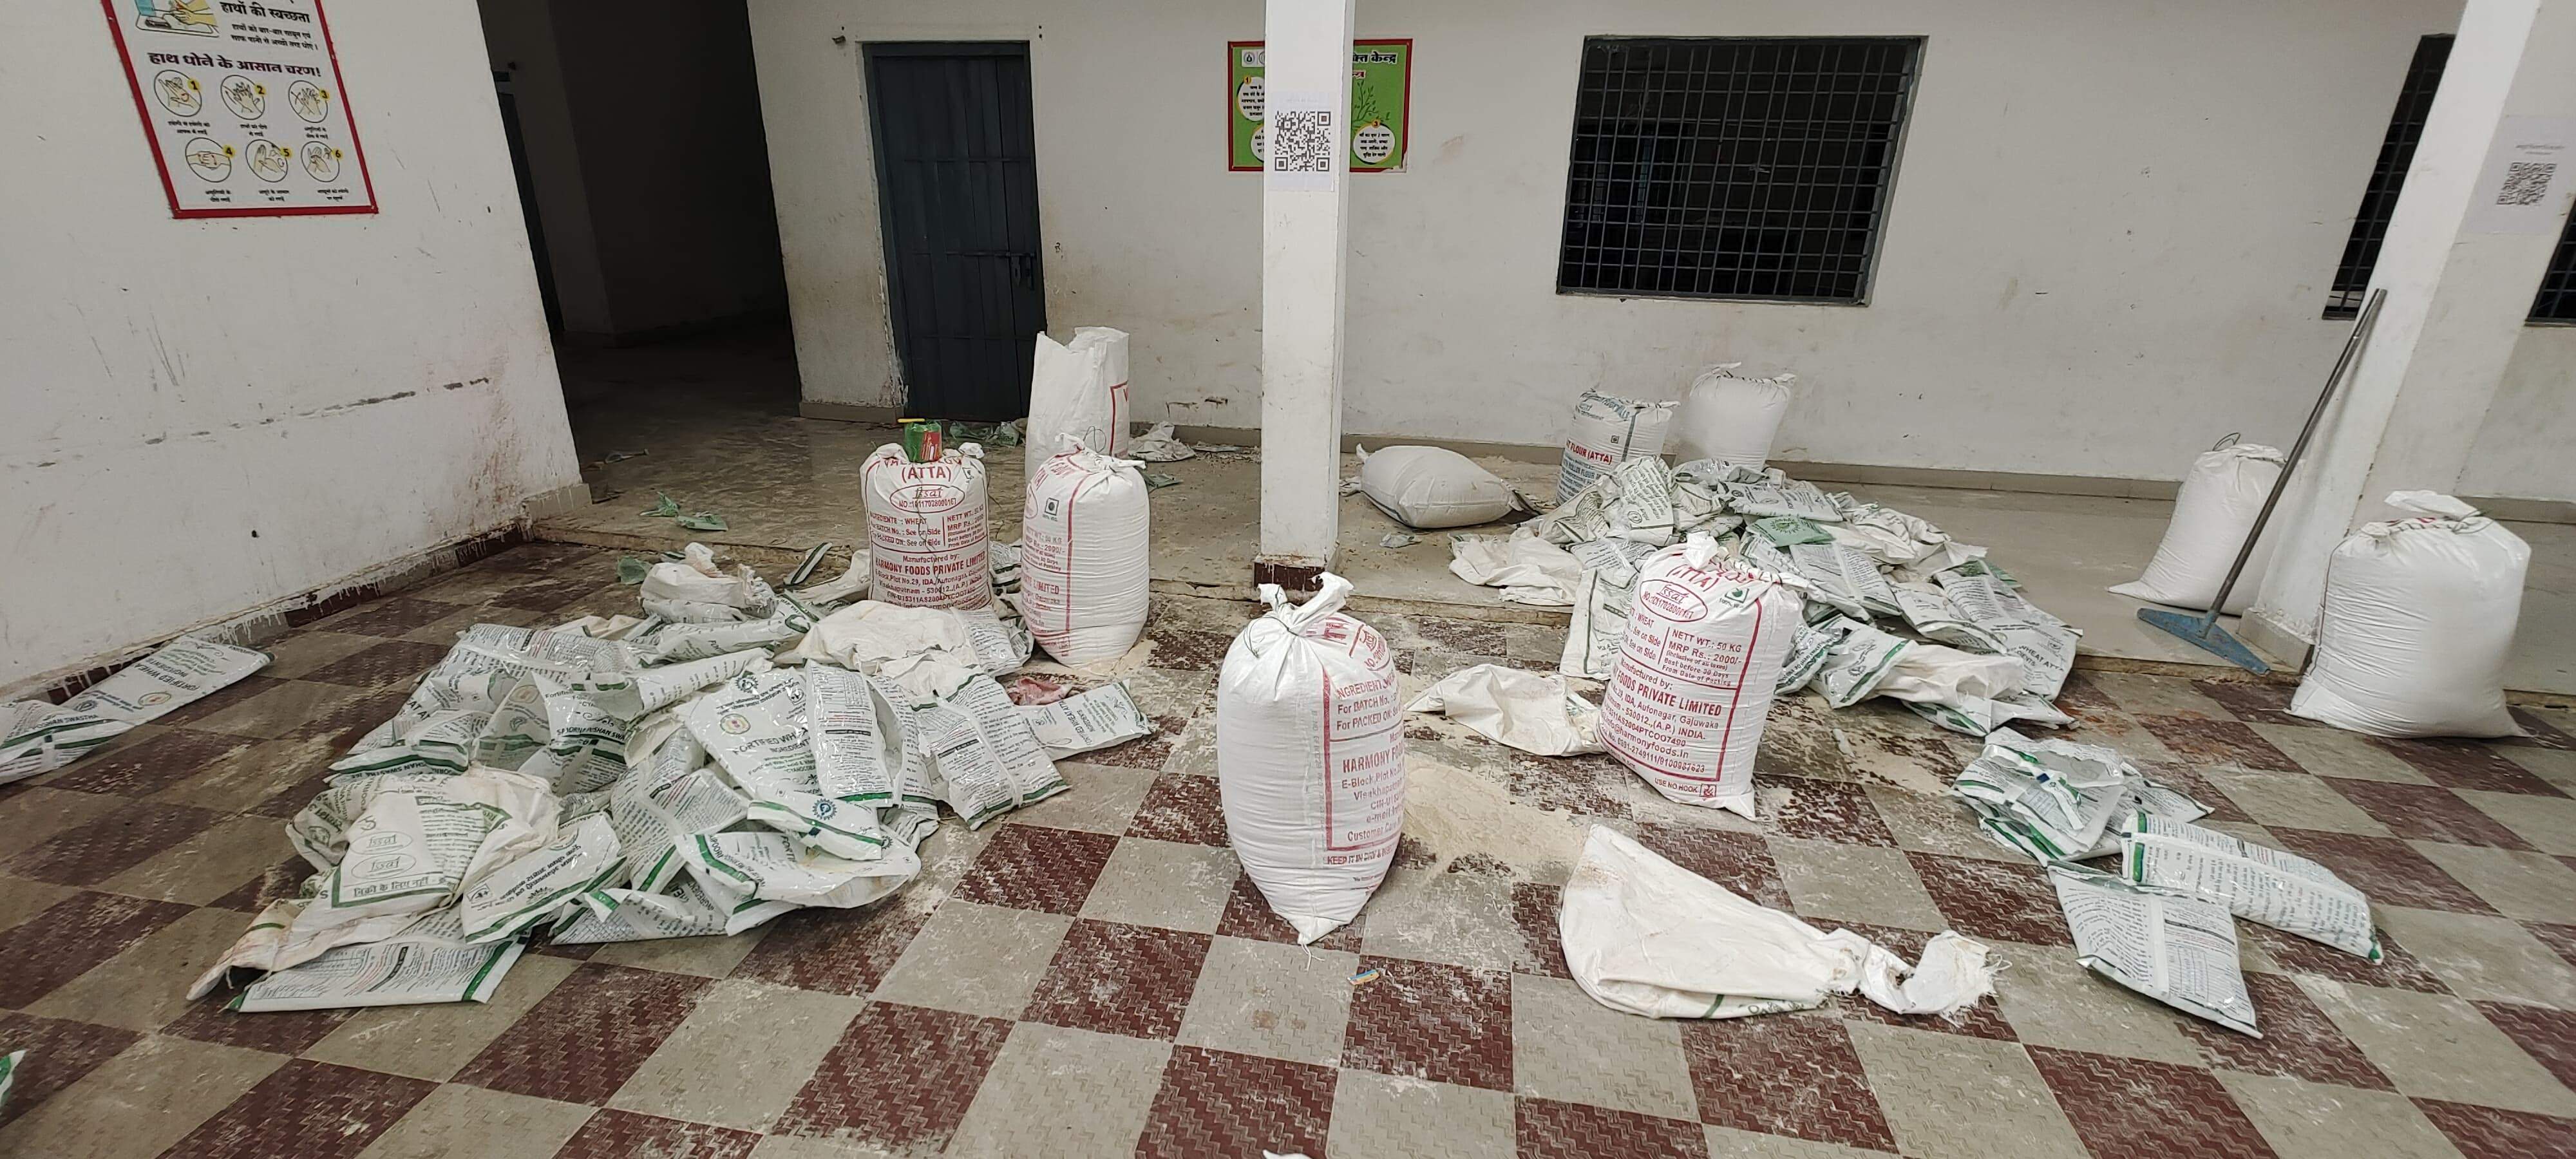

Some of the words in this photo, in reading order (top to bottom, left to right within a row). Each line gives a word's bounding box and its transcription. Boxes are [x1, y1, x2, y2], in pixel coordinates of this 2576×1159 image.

[249, 1, 266, 17] की
[268, 8, 310, 23] स्वच्छता
[147, 53, 178, 64] हाथ
[182, 52, 214, 68] धोने
[217, 55, 233, 69] के
[237, 60, 282, 73] आसान
[285, 64, 321, 77] चरण!
[1371, 51, 1396, 64] केन्द्र
[191, 82, 198, 90] 1
[257, 85, 265, 95] 2
[225, 147, 232, 156] 4
[283, 148, 290, 157] 5
[335, 150, 341, 158] 6
[1571, 443, 1587, 458] FLOUR
[1587, 449, 1613, 466] (ATTA)
[902, 466, 951, 484] (ATTA)
[903, 554, 949, 563] Manufactured
[905, 565, 930, 576] FOODS
[933, 560, 964, 575] PRIVATE
[966, 551, 985, 567] LIMITED
[1033, 580, 1059, 594] LIMITED
[1638, 612, 1654, 628] WHEAT
[1647, 633, 1662, 648] Side
[1672, 628, 1695, 643] NETT
[1716, 641, 1727, 651] 50
[1729, 643, 1742, 653] KG
[1643, 646, 1656, 661] Side
[1669, 641, 1689, 654] MRP
[1713, 653, 1742, 666] 2000/-
[2018, 645, 2045, 663] WHEAT
[1662, 664, 1678, 674] From
[1680, 670, 1695, 680] Date
[1680, 661, 1701, 674] before
[1712, 669, 1729, 679] Days
[1660, 677, 1674, 692] by:
[1616, 670, 1636, 692] FOODS
[1637, 681, 1677, 708] PRIVATE
[1679, 696, 1722, 717] LIMITED
[1338, 704, 1351, 715] For
[1354, 697, 1379, 712] BATCH
[1337, 720, 1350, 731] For
[1352, 713, 1381, 728] PACKED
[1679, 715, 1719, 730] Gajuwaka
[1678, 727, 1706, 740] INDIA.
[1343, 748, 1390, 773] HARMONY
[1654, 777, 1667, 787] USE
[1668, 780, 1678, 790] NO
[1678, 784, 1699, 794] HOOK
[1348, 825, 1384, 842] Customer
[1327, 855, 1347, 865] KEEP
